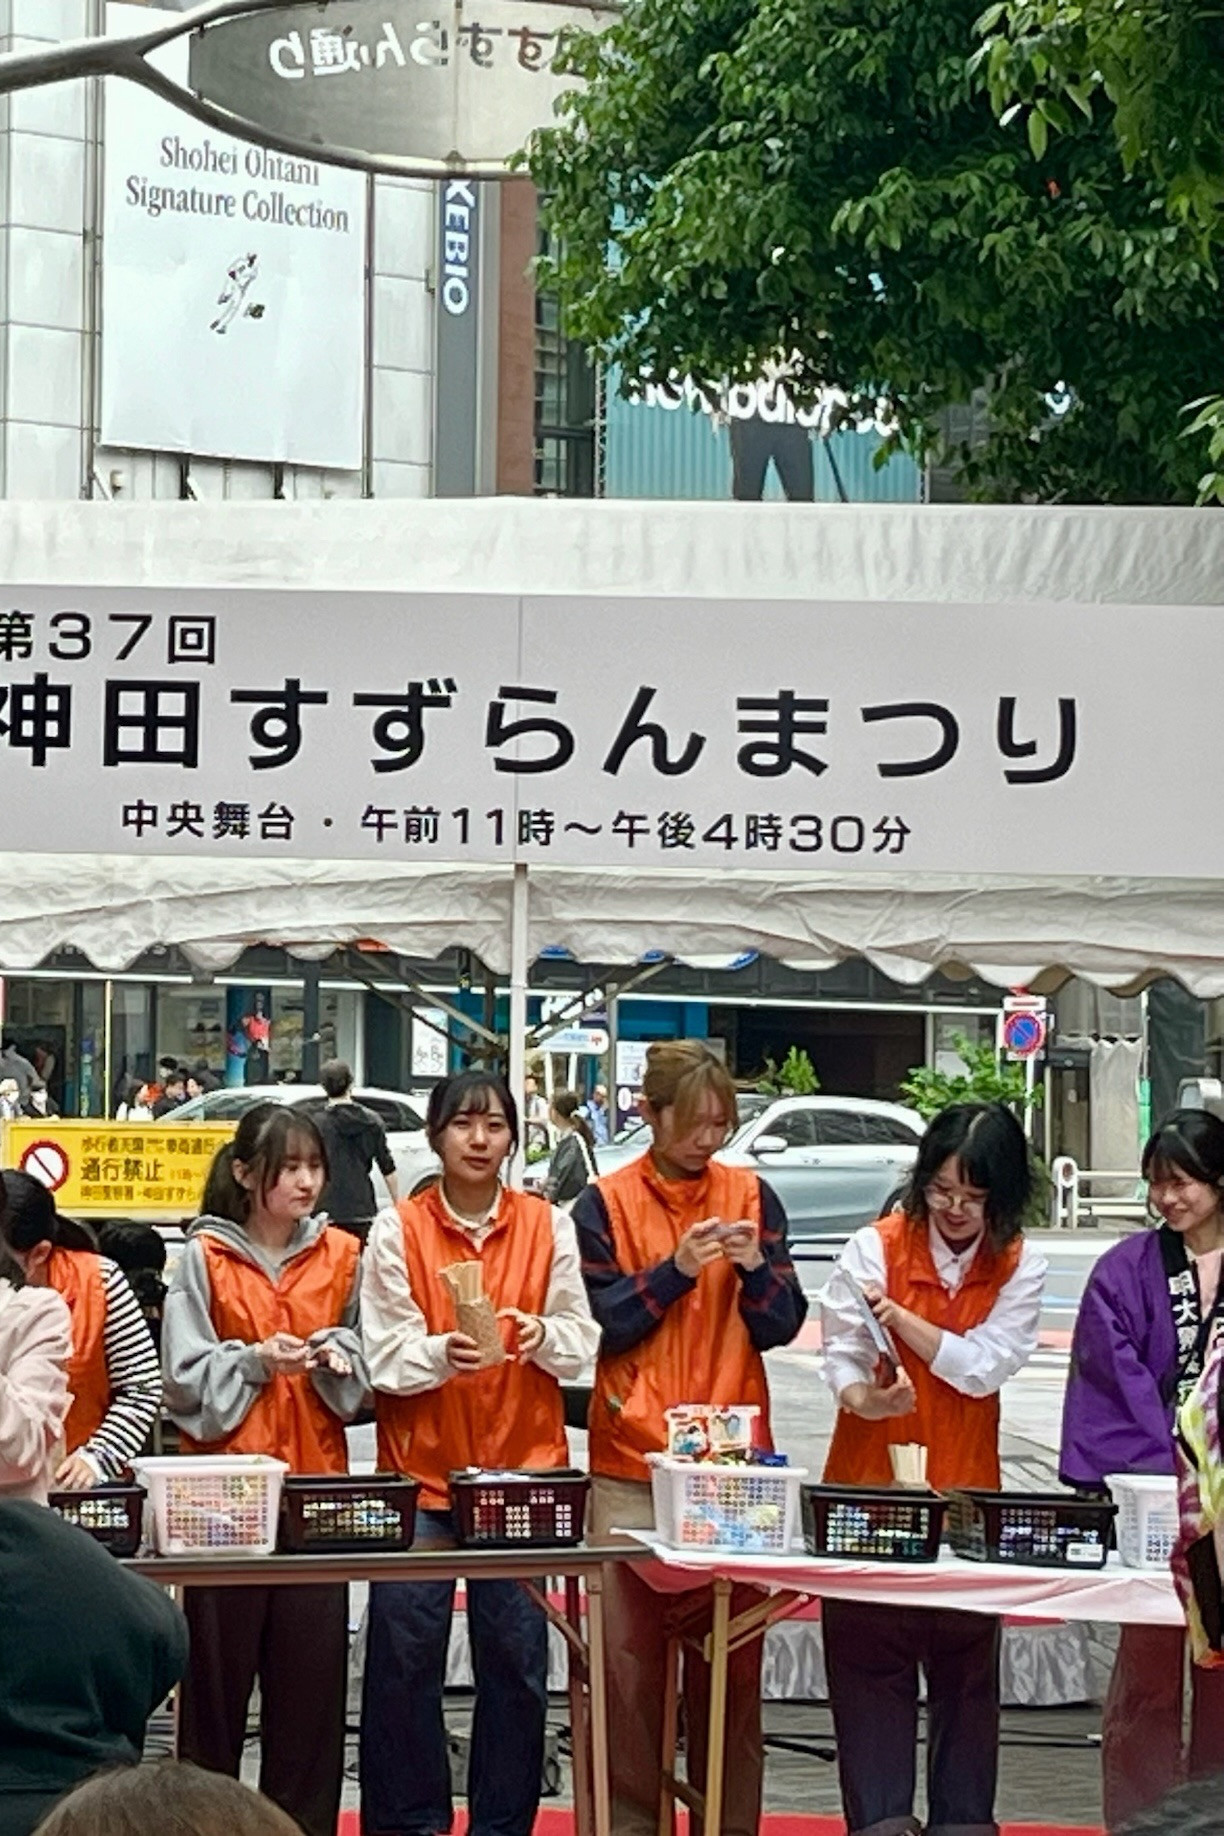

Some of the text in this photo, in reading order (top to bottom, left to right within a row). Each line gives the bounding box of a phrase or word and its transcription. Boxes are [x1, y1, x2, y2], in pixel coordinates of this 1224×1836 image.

[160, 135, 320, 187] Shohei Ohtani
[126, 174, 350, 232] Signature Collection
[80, 1157, 164, 1181] 通行禁止
